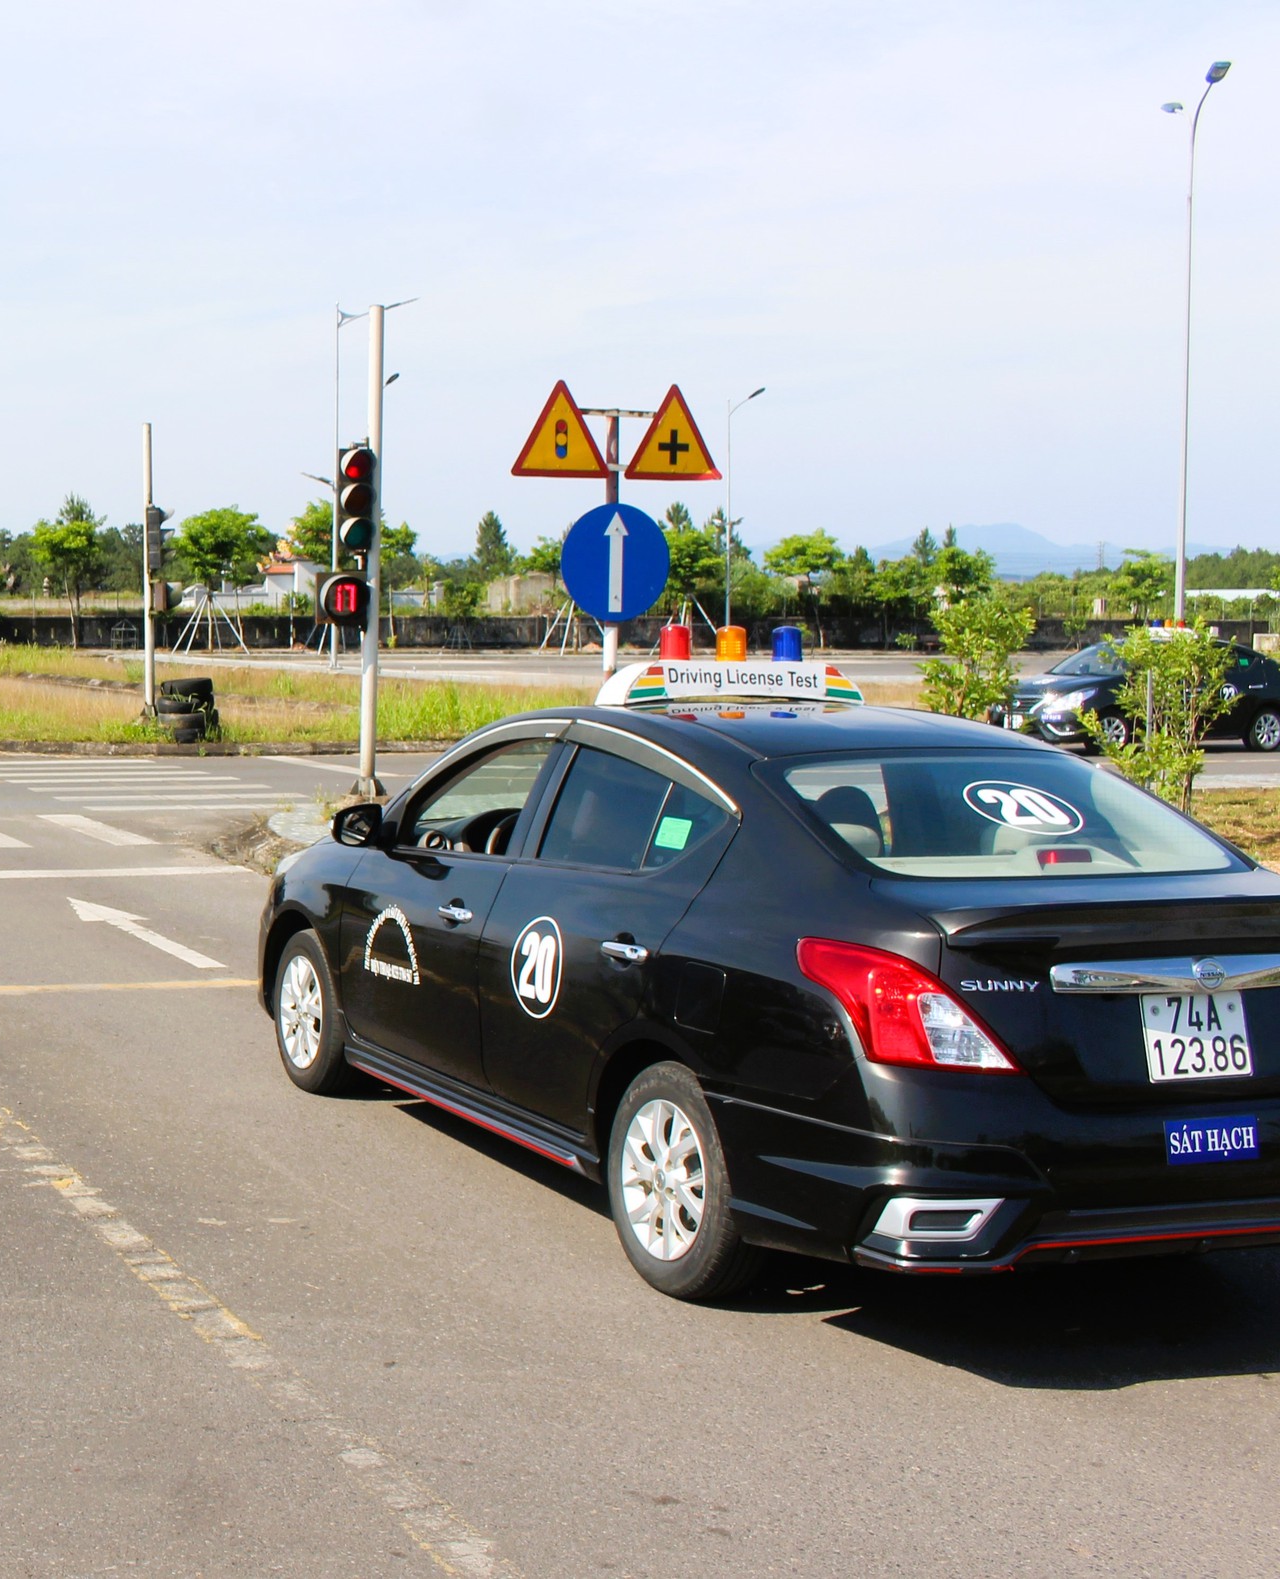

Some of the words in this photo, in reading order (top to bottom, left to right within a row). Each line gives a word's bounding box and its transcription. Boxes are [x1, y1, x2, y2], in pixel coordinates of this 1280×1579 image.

[668, 667, 722, 687] Driving
[727, 669, 783, 687] License
[787, 671, 818, 688] Test
[976, 788, 1071, 826] 20
[519, 931, 556, 1004] 20
[960, 979, 1040, 993] SUNNY
[1166, 994, 1222, 1034] 74A
[1153, 1033, 1247, 1076] 123.86
[1170, 1124, 1203, 1155] SÁT
[1206, 1126, 1255, 1157] HẠCH
